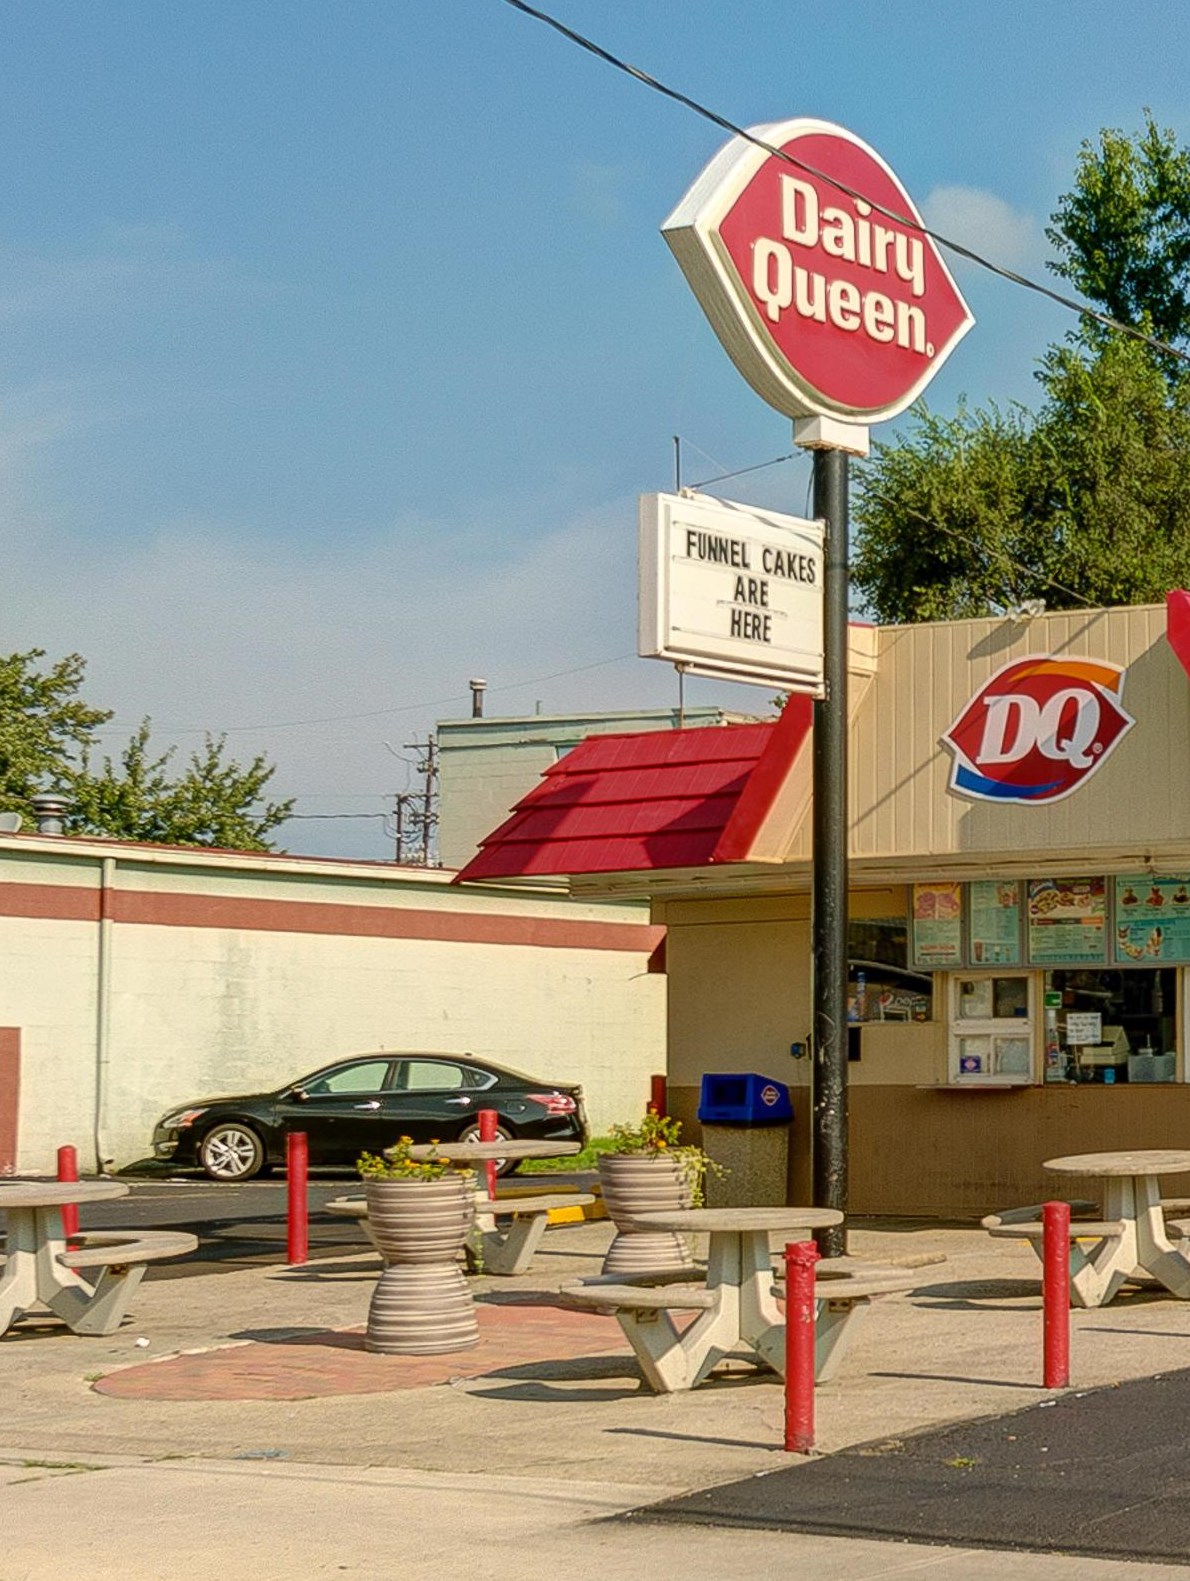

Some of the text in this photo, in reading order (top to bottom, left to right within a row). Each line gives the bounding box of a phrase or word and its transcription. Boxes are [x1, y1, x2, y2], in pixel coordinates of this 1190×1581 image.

[779, 173, 925, 297] Dairy
[751, 236, 928, 357] Queen
[686, 530, 816, 584] FUNNEL CAKES
[734, 575, 769, 606] ARE
[730, 608, 772, 642] HERE
[975, 687, 1101, 769] DQ
